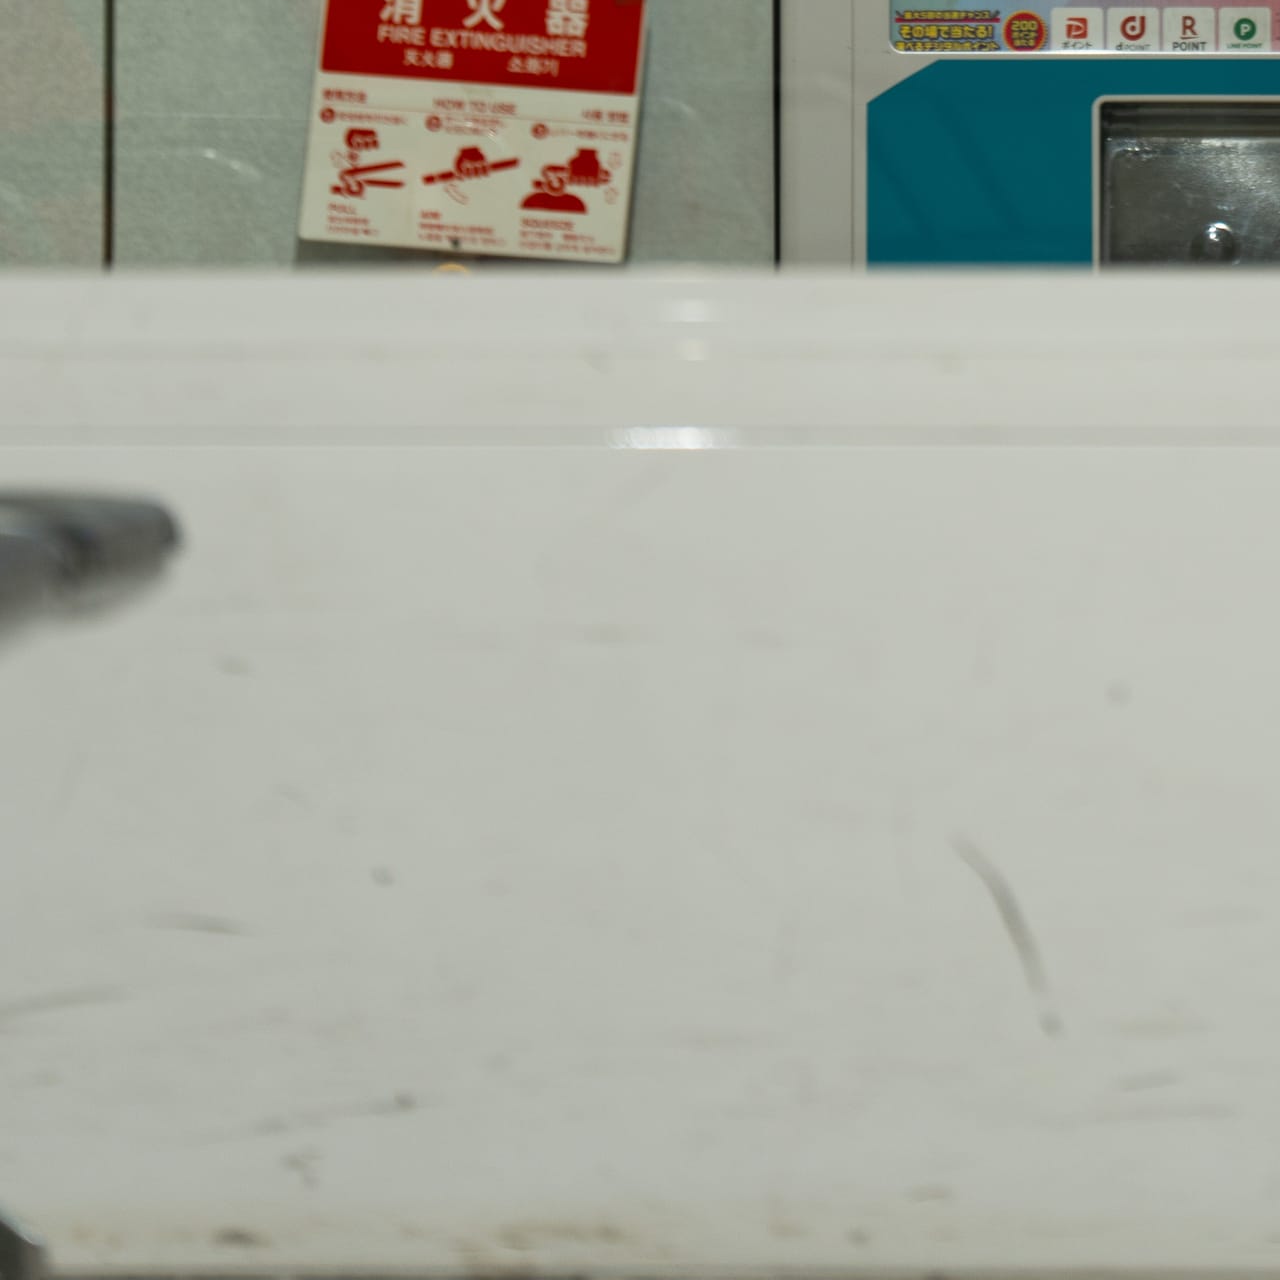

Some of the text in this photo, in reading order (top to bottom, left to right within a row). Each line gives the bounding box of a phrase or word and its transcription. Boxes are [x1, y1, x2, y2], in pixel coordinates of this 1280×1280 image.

[1011, 20, 1038, 31] 200
[376, 24, 588, 58] FIRE EXTINGUISHER
[1172, 41, 1206, 51] POINT
